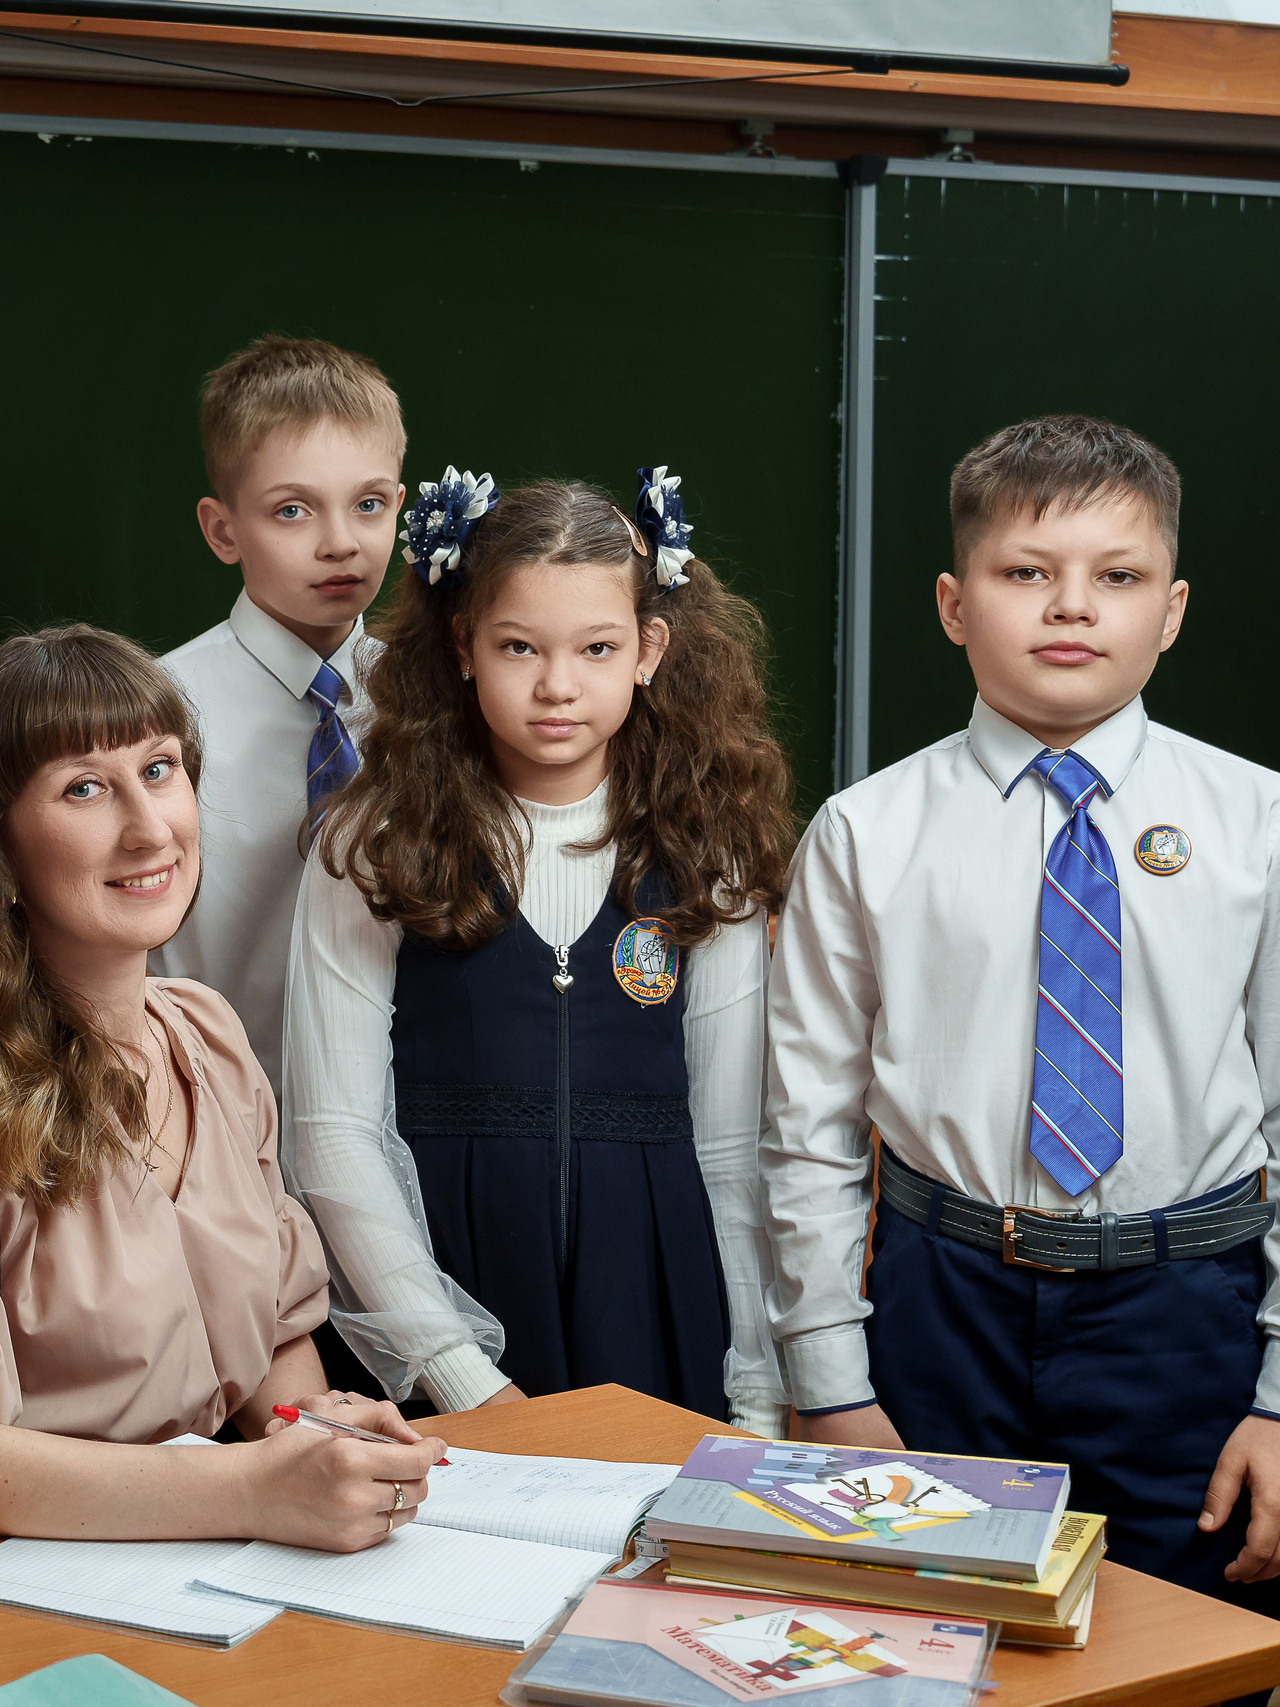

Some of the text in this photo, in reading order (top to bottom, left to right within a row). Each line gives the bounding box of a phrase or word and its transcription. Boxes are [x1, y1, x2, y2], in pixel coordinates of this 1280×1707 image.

[1002, 1479, 1034, 1487] 4
[763, 1489, 842, 1530] Русский язык
[920, 1638, 955, 1648] 4
[660, 1625, 773, 1692] Математика
